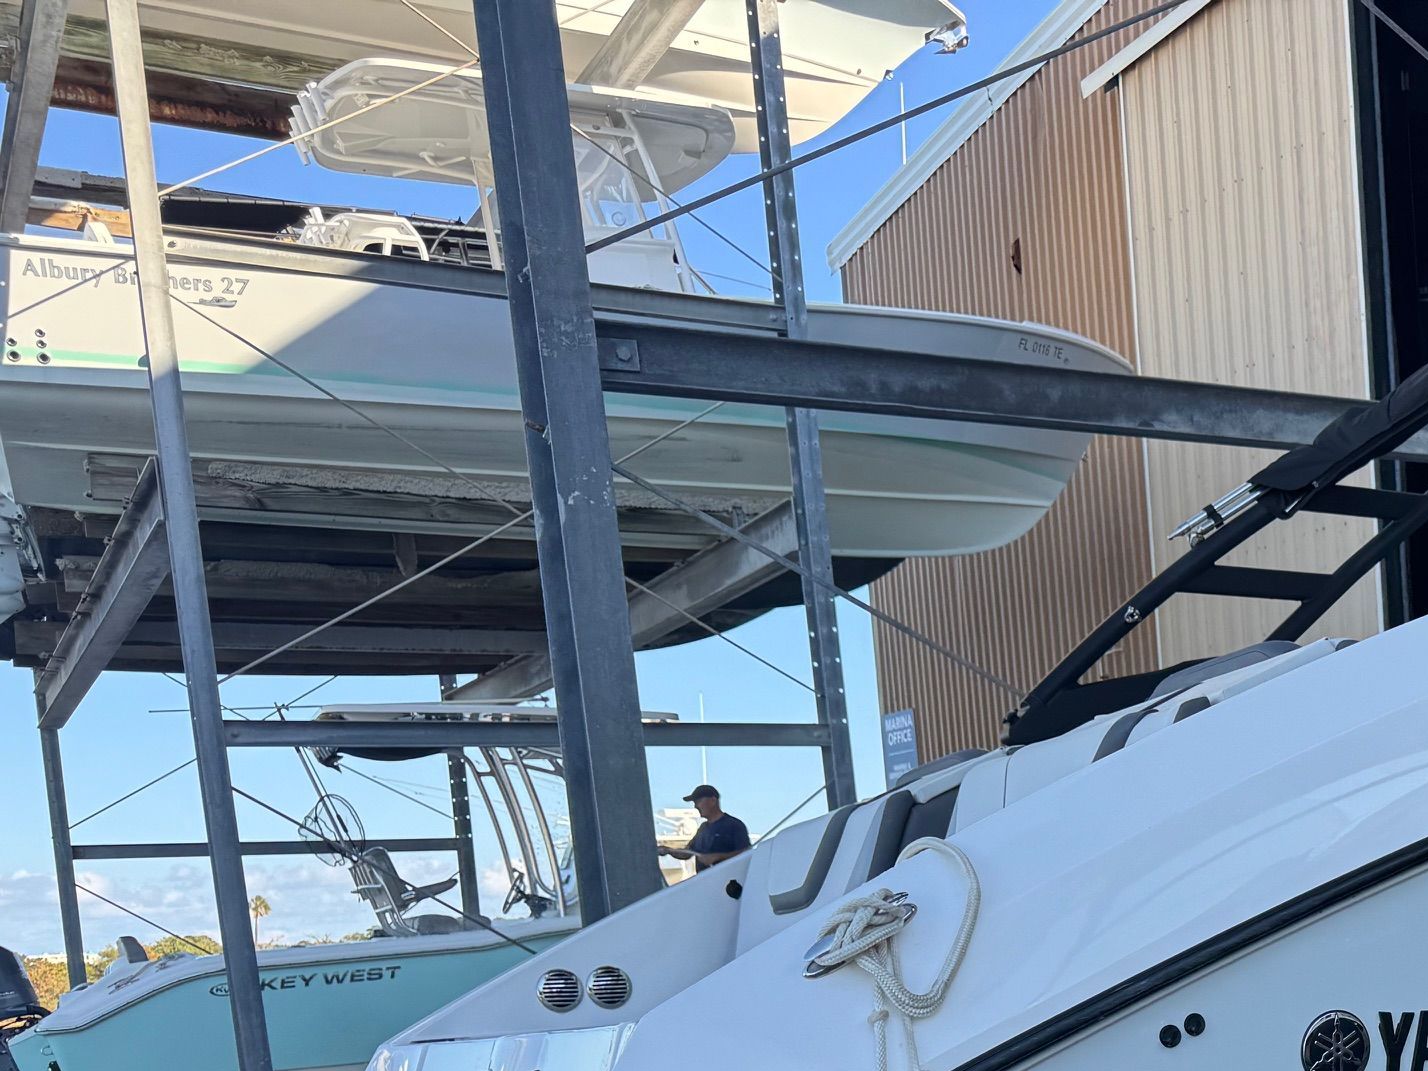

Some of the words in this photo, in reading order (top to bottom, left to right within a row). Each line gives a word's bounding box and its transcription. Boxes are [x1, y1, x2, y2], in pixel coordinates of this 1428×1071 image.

[22, 257, 104, 288] Albury
[113, 266, 213, 293] Brhers
[220, 276, 250, 296] 27
[1018, 337, 1029, 351] FL
[1053, 346, 1063, 360] TE
[885, 713, 913, 732] MARINA
[888, 728, 912, 747] OFFICE
[261, 972, 318, 991] KEY
[324, 965, 401, 985] WEST
